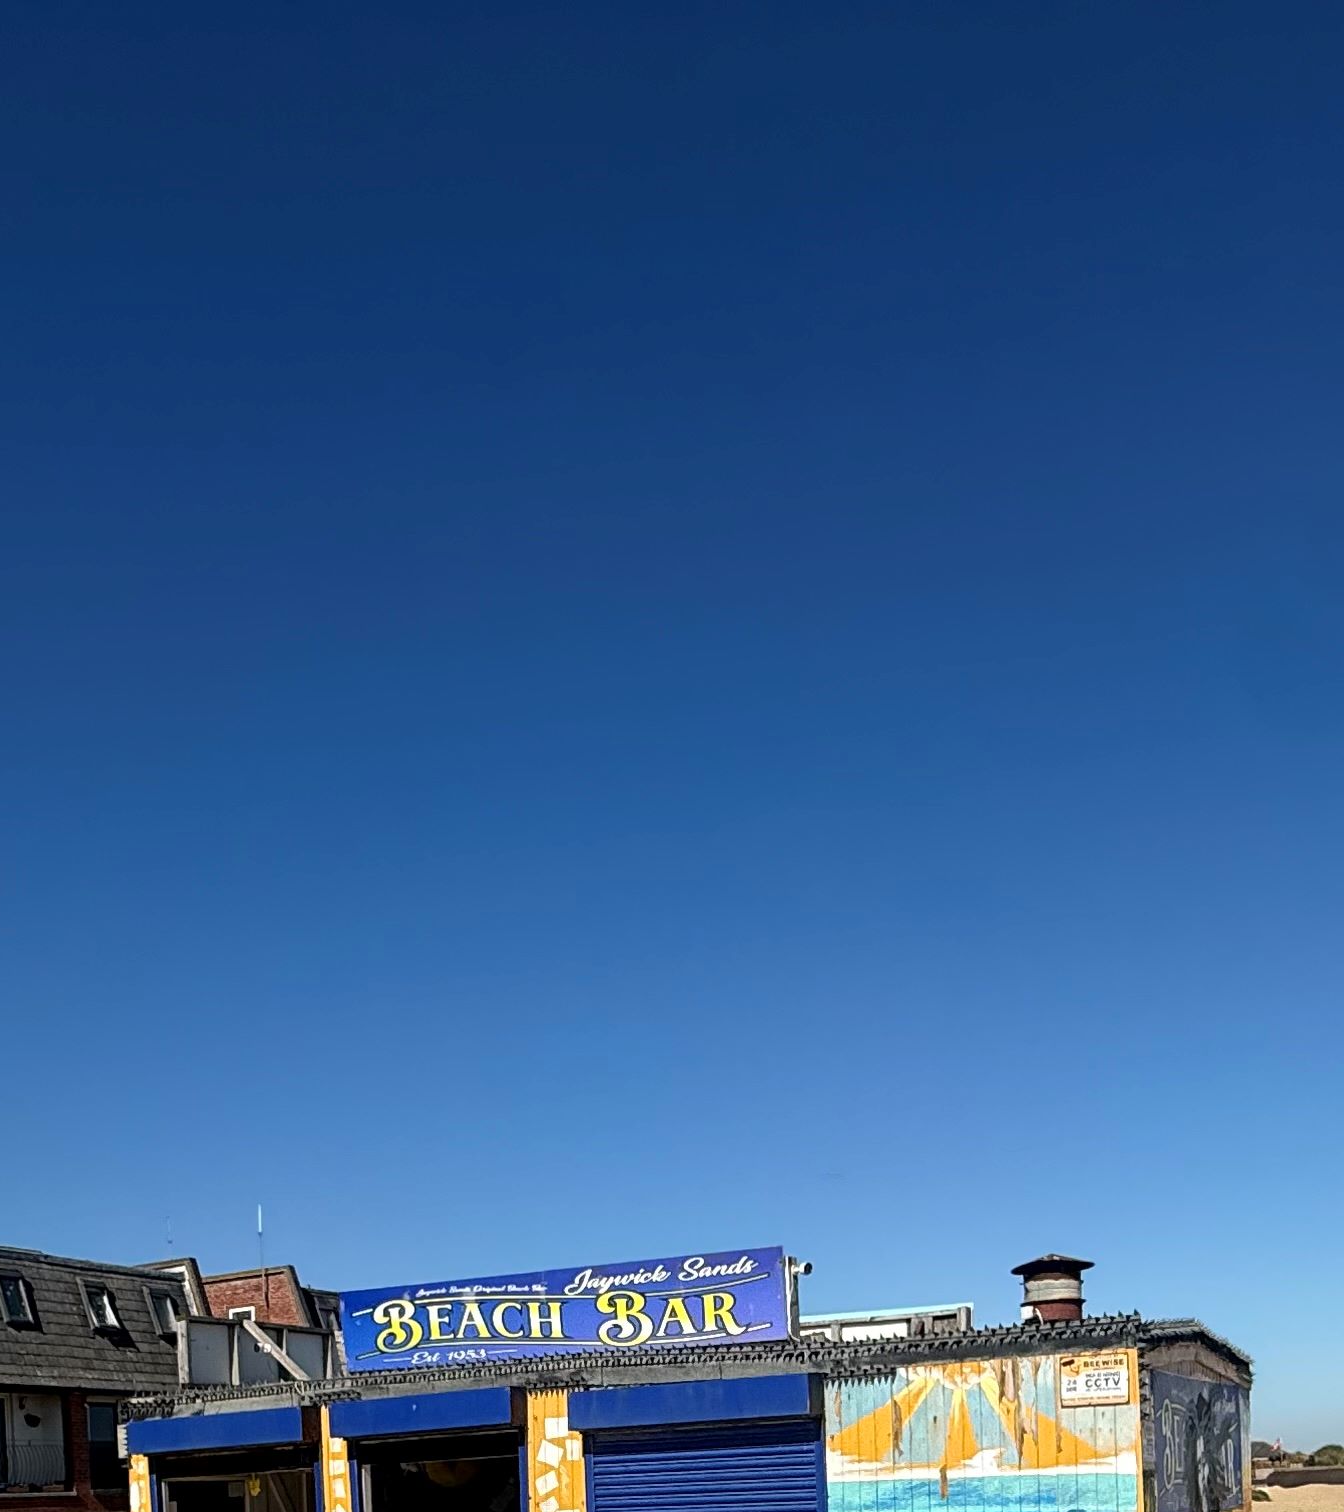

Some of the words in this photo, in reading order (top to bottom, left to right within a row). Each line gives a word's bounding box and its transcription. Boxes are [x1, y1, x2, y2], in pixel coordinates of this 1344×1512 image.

[564, 1268, 671, 1296] Jaywick
[677, 1255, 759, 1282] Sands
[373, 1299, 565, 1353] BEACH
[596, 1290, 747, 1347] BAR
[411, 1351, 441, 1364] Est
[447, 1348, 487, 1361] 1953
[1085, 1376, 1121, 1388] CCTV
